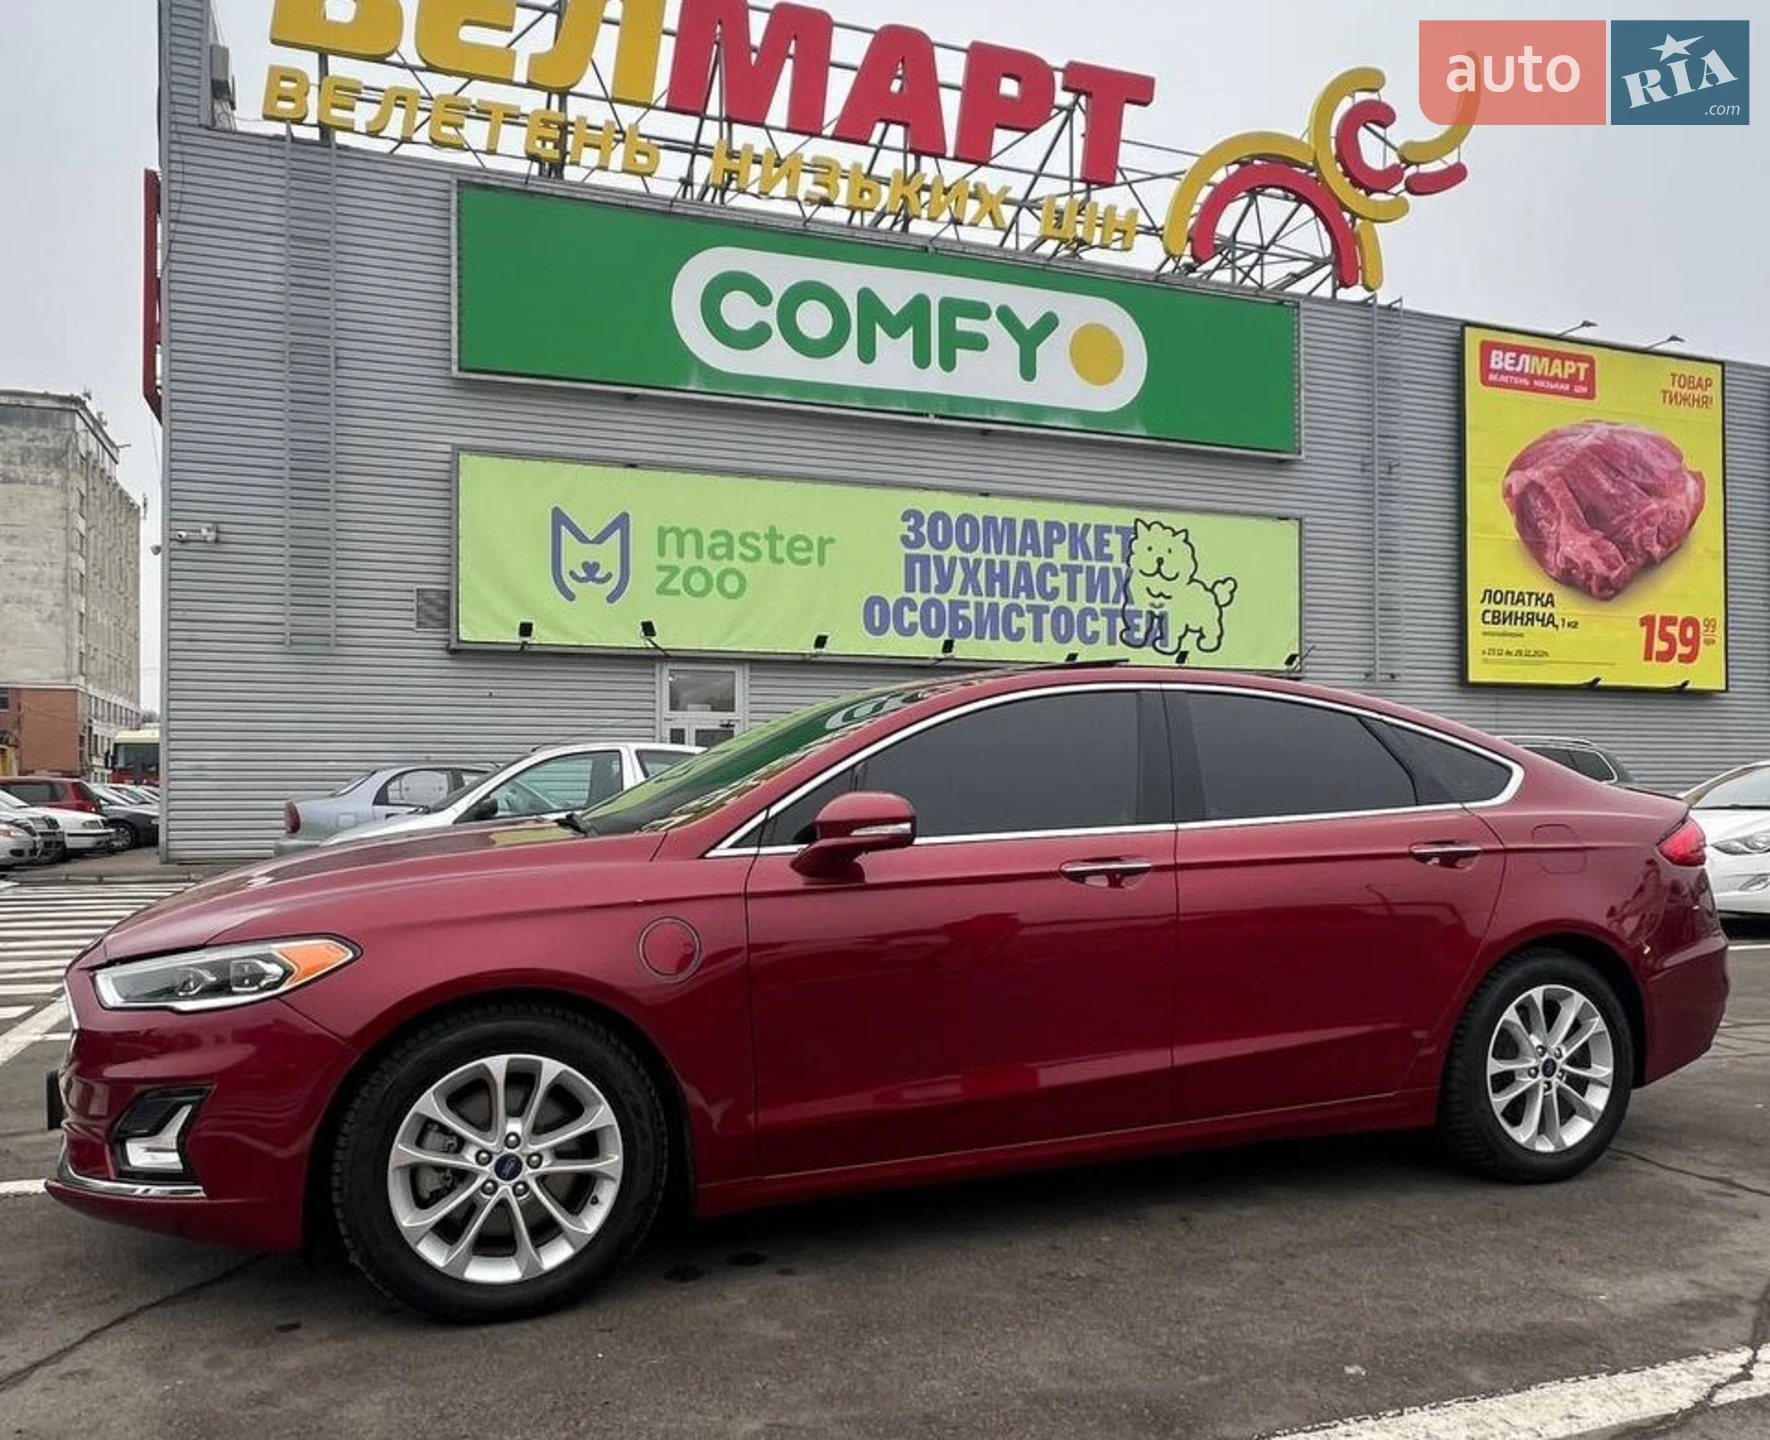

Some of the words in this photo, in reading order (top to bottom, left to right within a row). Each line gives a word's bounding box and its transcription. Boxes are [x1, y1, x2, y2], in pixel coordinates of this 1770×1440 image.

[262, 64, 661, 178] ВЕЛЕТЕНЬ
[708, 139, 1013, 230] НИЗЬКИХ
[1040, 194, 1139, 252] ЦІН
[700, 269, 1060, 383] COMFY
[1489, 350, 1589, 381] ВЕЛМАРТ
[1670, 372, 1713, 392] ТОВАР
[1661, 389, 1714, 409] ТИЖНЯ!
[656, 524, 836, 567] master
[900, 508, 1136, 564] ЗООМАРКЕТ
[655, 565, 747, 600] zoo
[903, 553, 1135, 606] ПУХНАСТИХ
[1480, 588, 1556, 608] ЛОПАТКА
[1481, 610, 1559, 631] СВИНЯЧА,
[1703, 617, 1717, 633] 99
[1639, 614, 1701, 664] 159
